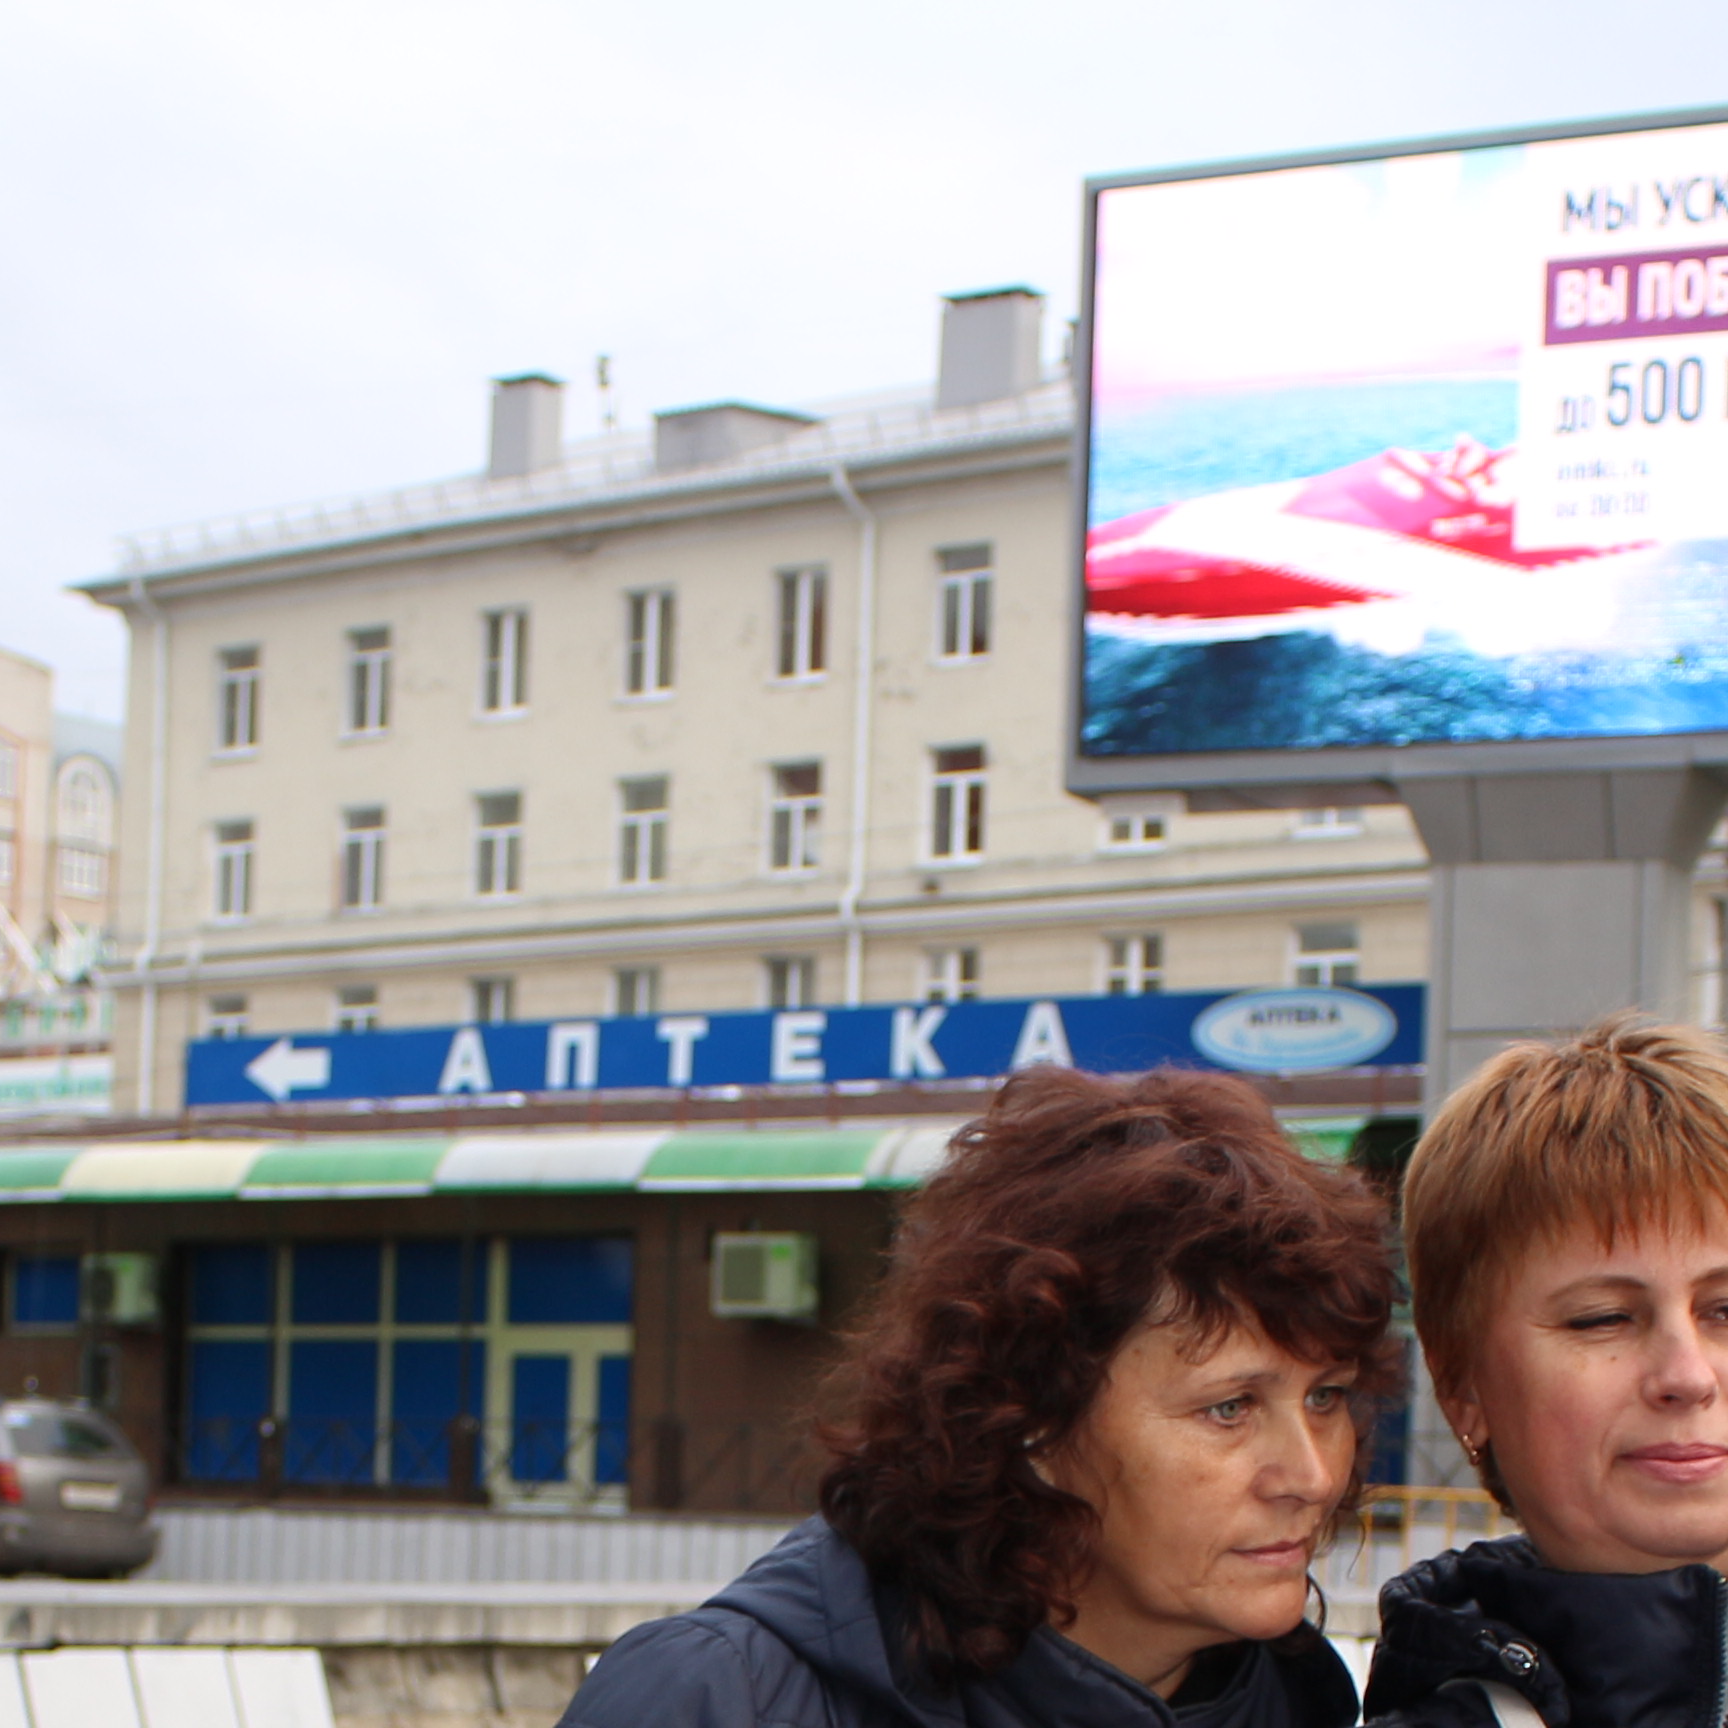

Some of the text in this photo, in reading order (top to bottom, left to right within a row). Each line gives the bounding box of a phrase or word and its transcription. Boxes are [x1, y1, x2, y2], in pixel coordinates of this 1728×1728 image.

[1563, 184, 1638, 232] МЫ
[1554, 265, 1628, 329] ВЫ
[1608, 355, 1703, 427] 500
[437, 1001, 1073, 1094] АПТЕКА
